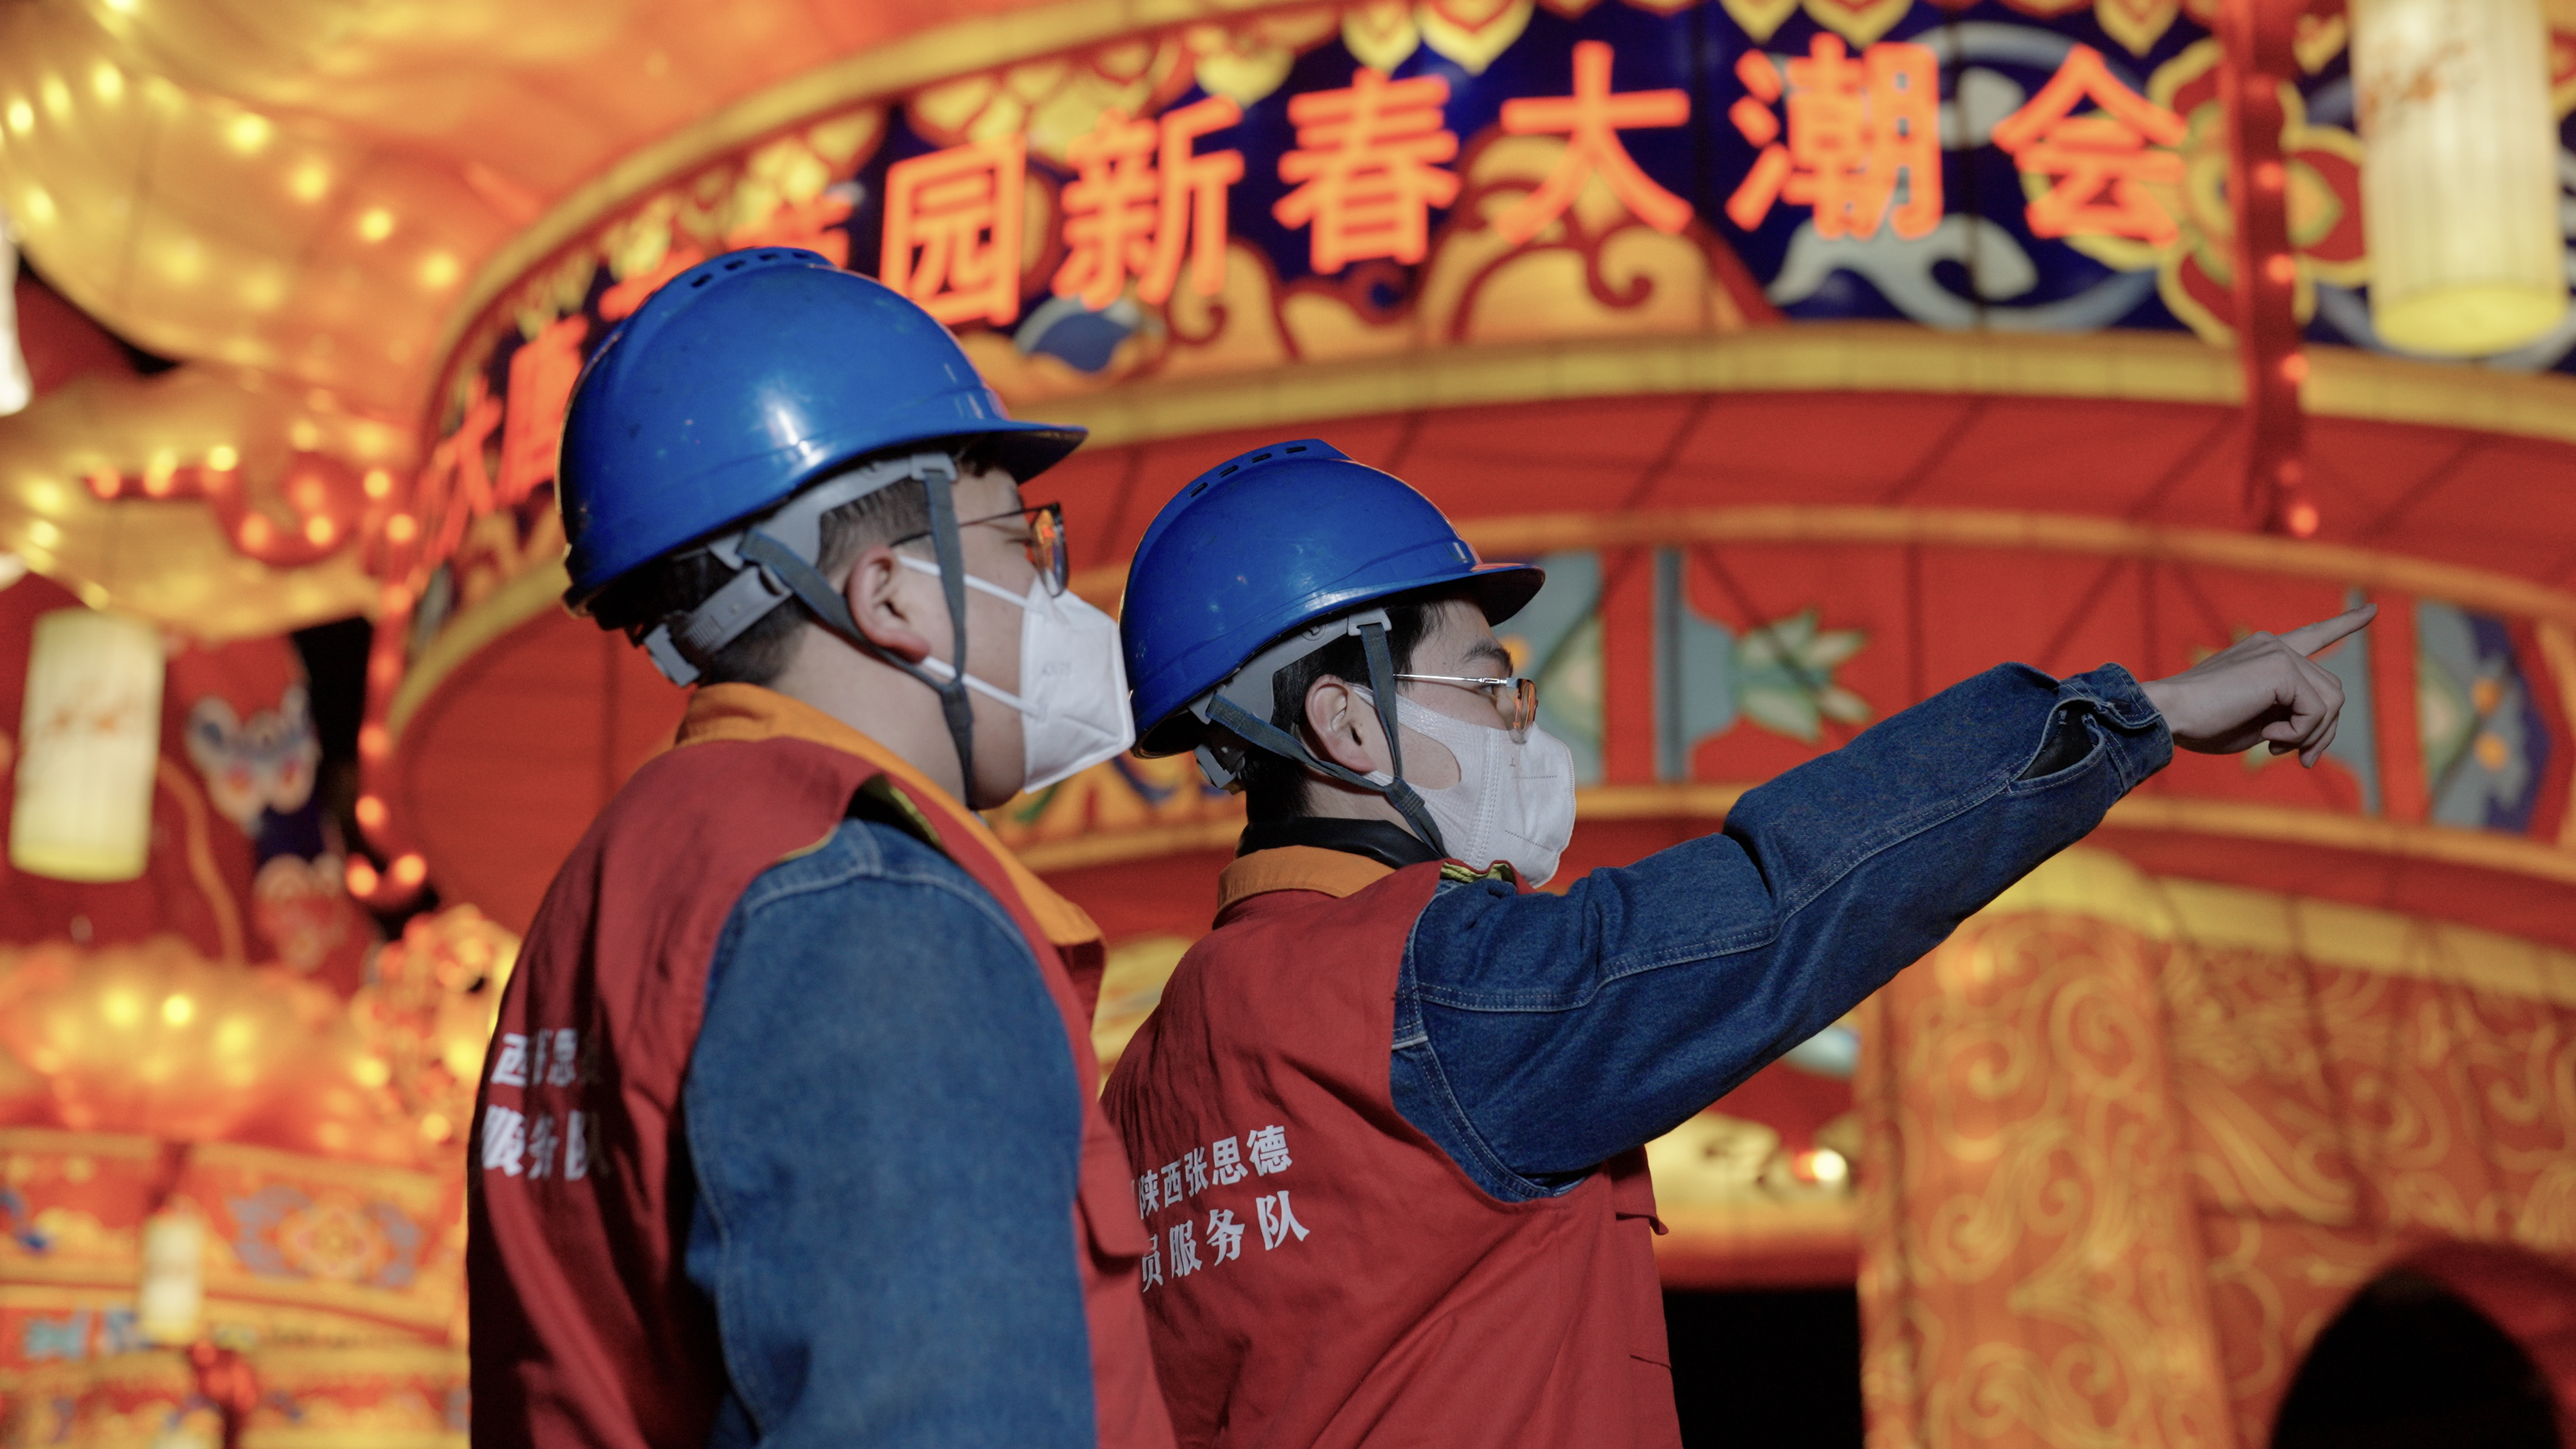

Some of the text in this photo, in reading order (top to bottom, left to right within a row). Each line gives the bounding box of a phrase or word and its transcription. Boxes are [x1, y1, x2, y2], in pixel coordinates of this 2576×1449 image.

[426, 32, 2188, 562] 大唐园新春大潮会
[1132, 1124, 1293, 1220] 陕西张思德
[1142, 1190, 1310, 1293] 员服务队
